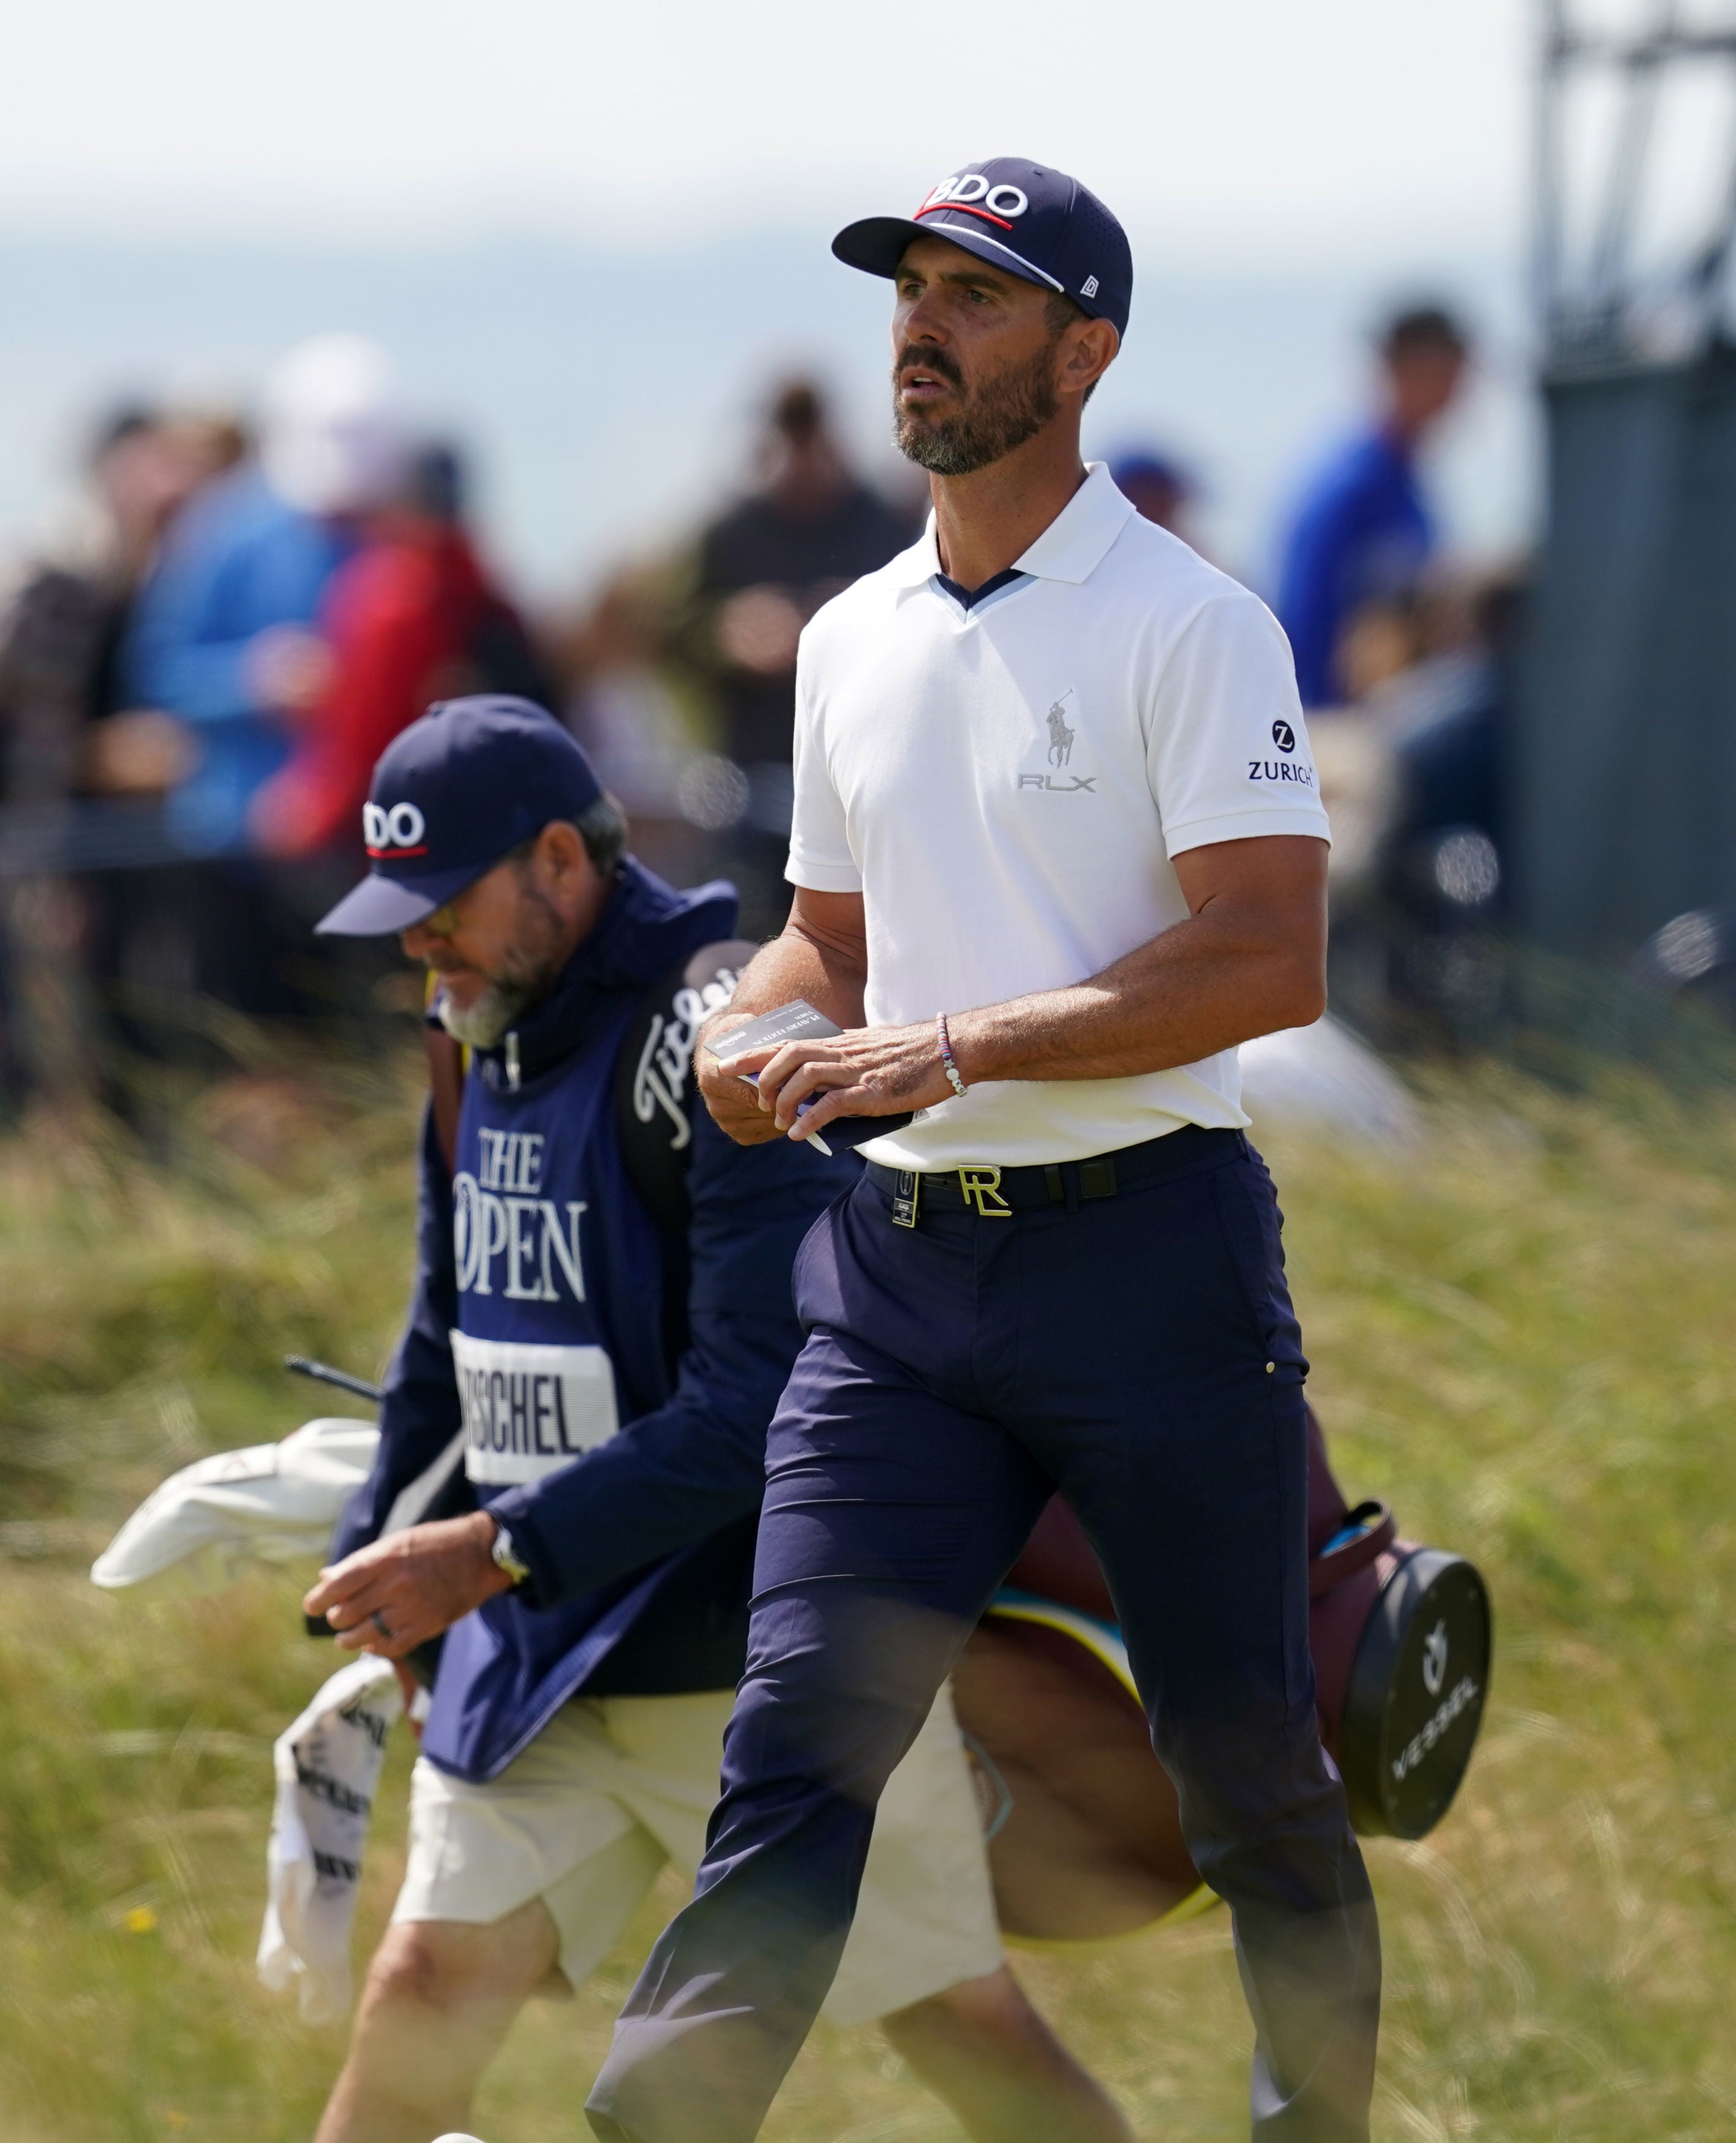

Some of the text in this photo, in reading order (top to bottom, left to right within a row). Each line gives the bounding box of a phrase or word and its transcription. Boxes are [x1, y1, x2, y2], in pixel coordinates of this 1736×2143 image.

[925, 174, 1029, 218] BDO
[1018, 773, 1097, 793] RLX
[1249, 761, 1313, 788] ZURICH
[363, 801, 425, 849] DO
[633, 967, 746, 1150] Titlei
[752, 1028, 786, 1047] EDITION
[478, 1127, 544, 1193] THE
[453, 1171, 587, 1302] OPEN
[464, 1368, 581, 1455] SCHEL
